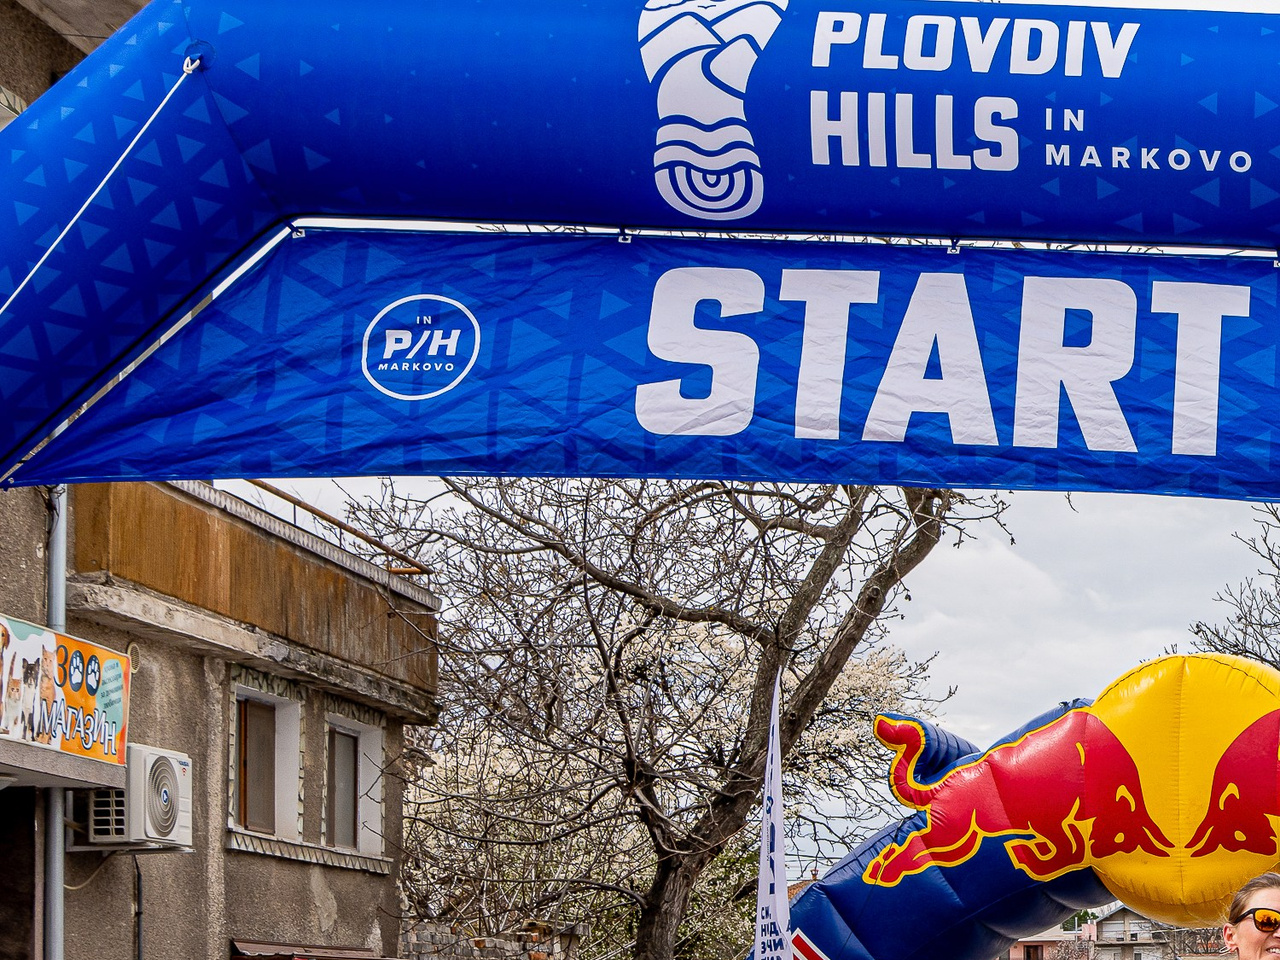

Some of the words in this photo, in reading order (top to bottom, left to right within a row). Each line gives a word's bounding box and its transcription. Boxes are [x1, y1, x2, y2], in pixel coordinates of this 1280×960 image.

[811, 12, 1141, 78] PLOVDIV
[811, 90, 1019, 171] HILLS
[1045, 108, 1085, 131] IN
[1045, 144, 1253, 173] MARKOVO
[416, 315, 432, 325] IN
[383, 329, 461, 359] P/H
[378, 362, 454, 371] MARKOVO
[635, 266, 1251, 456] START
[40, 698, 117, 755] МАГАЗИН
